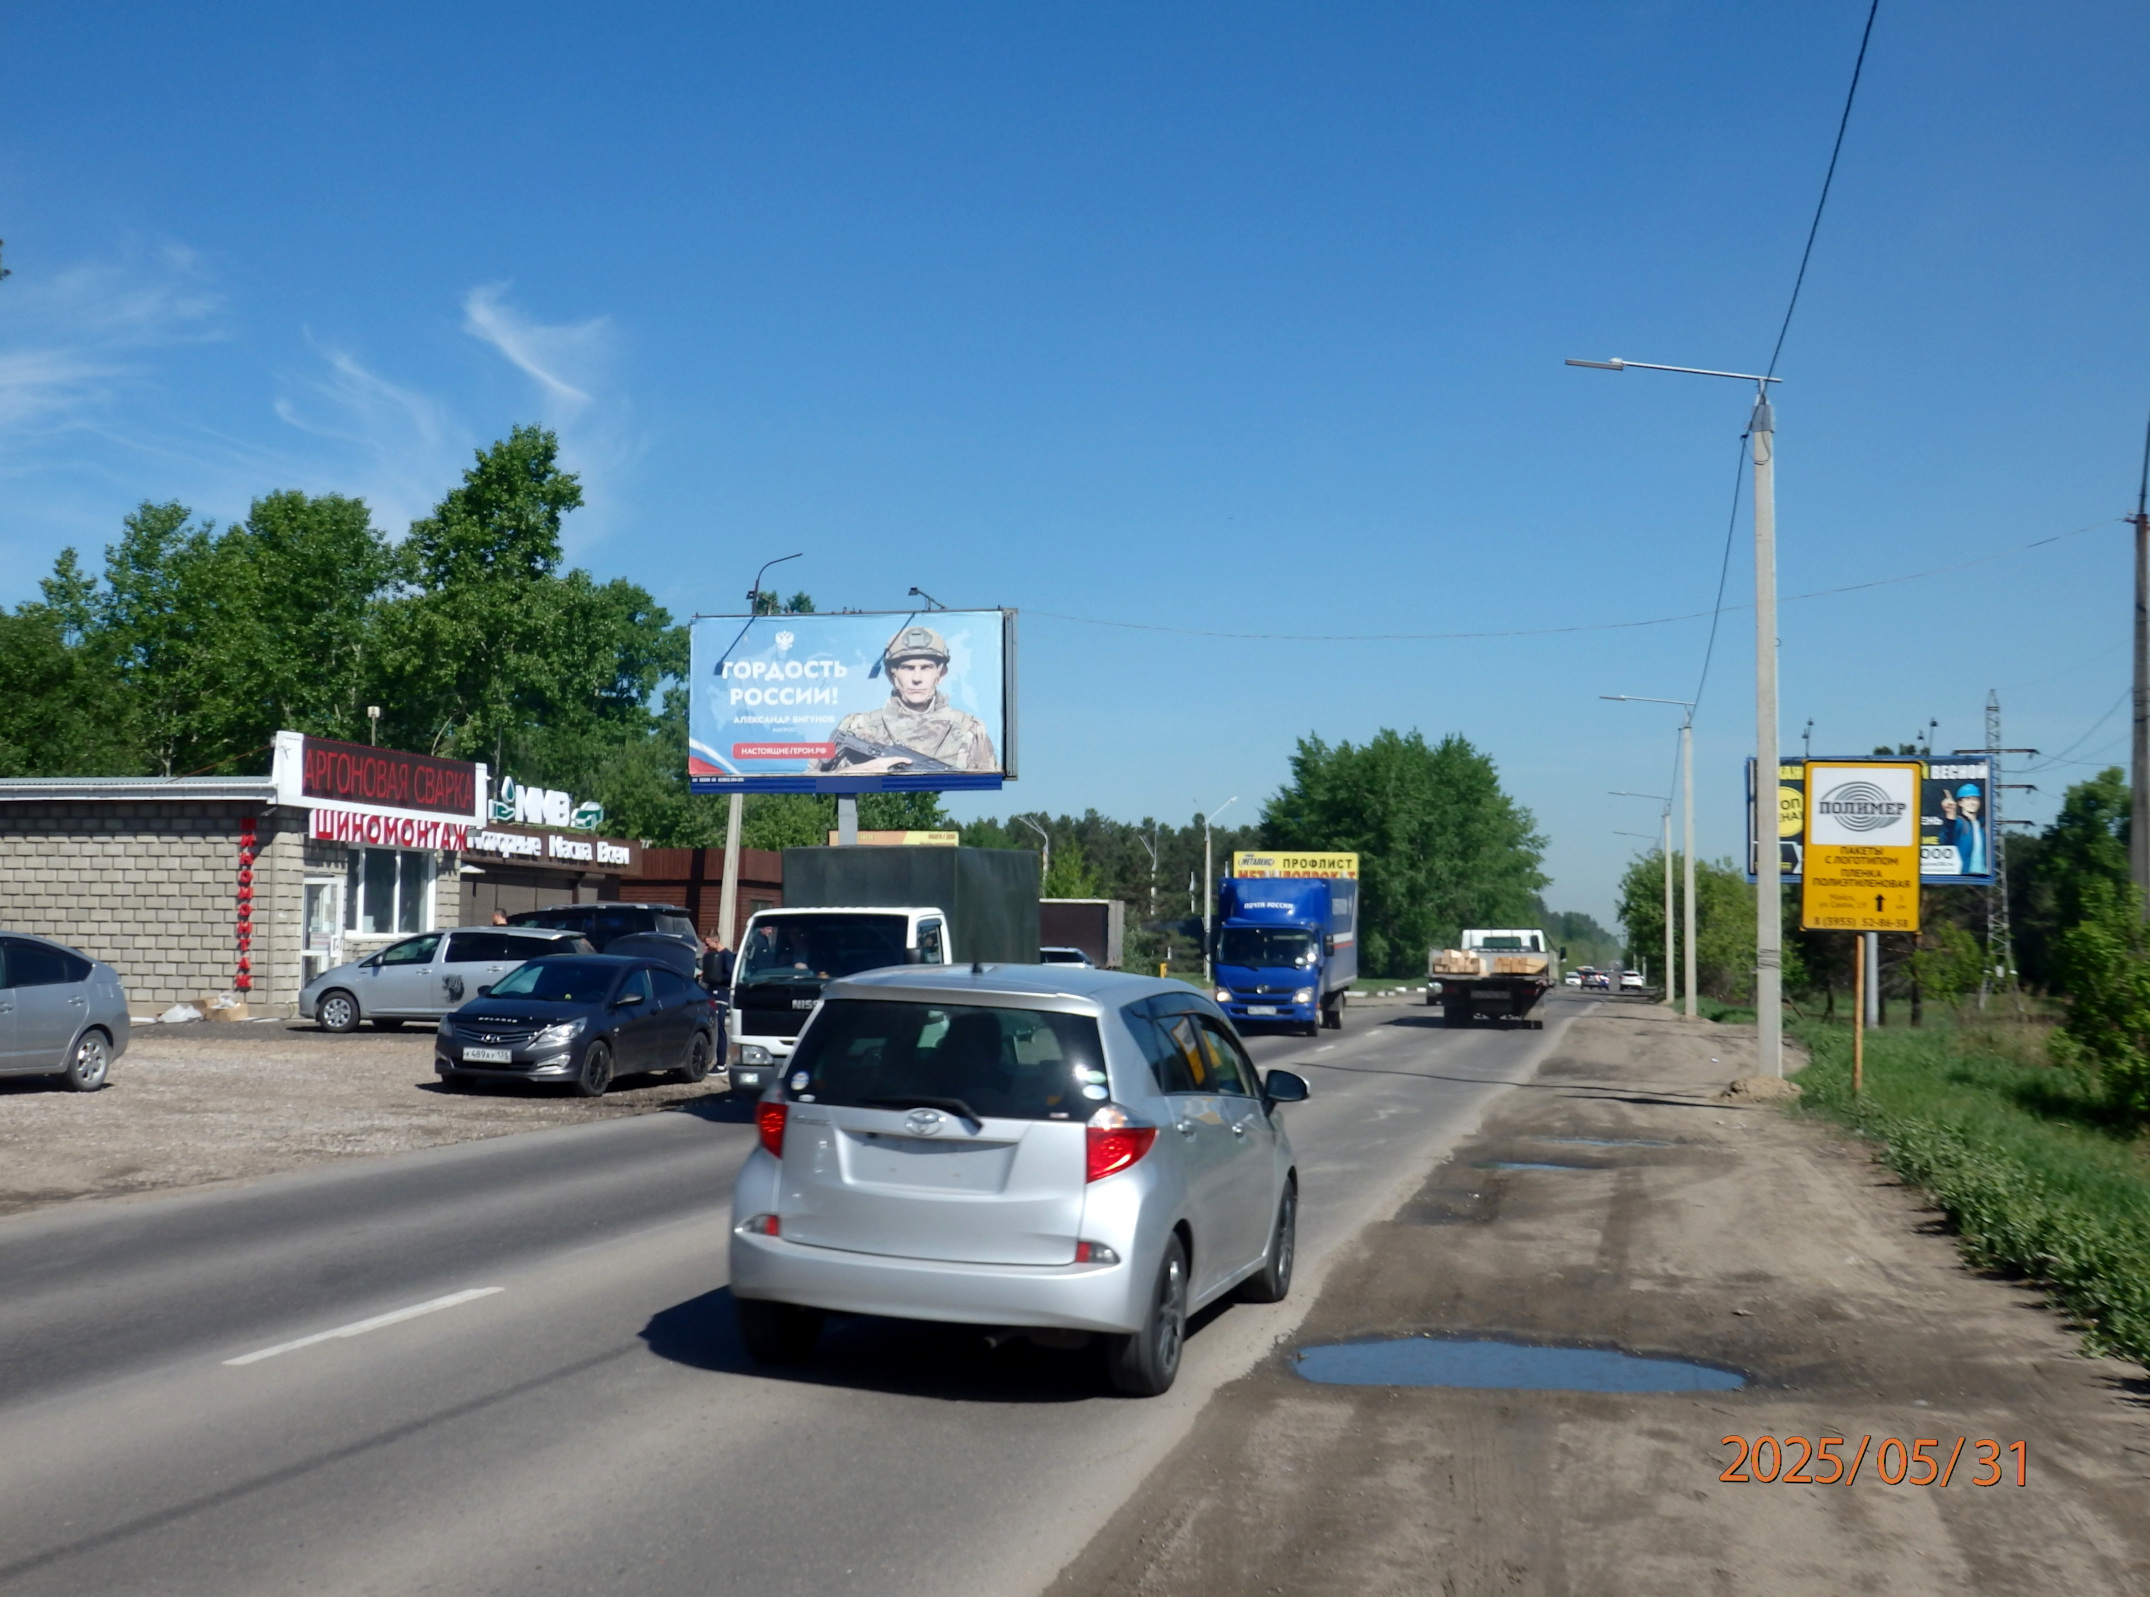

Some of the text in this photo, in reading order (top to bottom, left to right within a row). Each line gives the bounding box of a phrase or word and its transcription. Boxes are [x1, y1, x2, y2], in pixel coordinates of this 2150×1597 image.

[721, 660, 848, 681] ГОРДОСТЬ
[730, 687, 839, 706] РОССИИ!
[733, 715, 791, 724] АЛЕКСАНДР
[304, 749, 473, 809] АРГОНОВАЯ СВАРКА
[1819, 801, 1907, 816] ПОЛИМЕР
[313, 809, 468, 851] ШИНОМОНТАЖ
[1840, 846, 1884, 856] ПАКЕТЫ
[1282, 858, 1353, 869] ПРОФЛИСТ
[1833, 856, 1899, 866] ЛОГОТИПОМ
[1840, 869, 1883, 877] ПЛЕНКА
[1812, 878, 1911, 888] ПОЛИЭТИЛЕНОВАЯ
[1813, 916, 1821, 926] 8
[791, 999, 818, 1010] NISS
